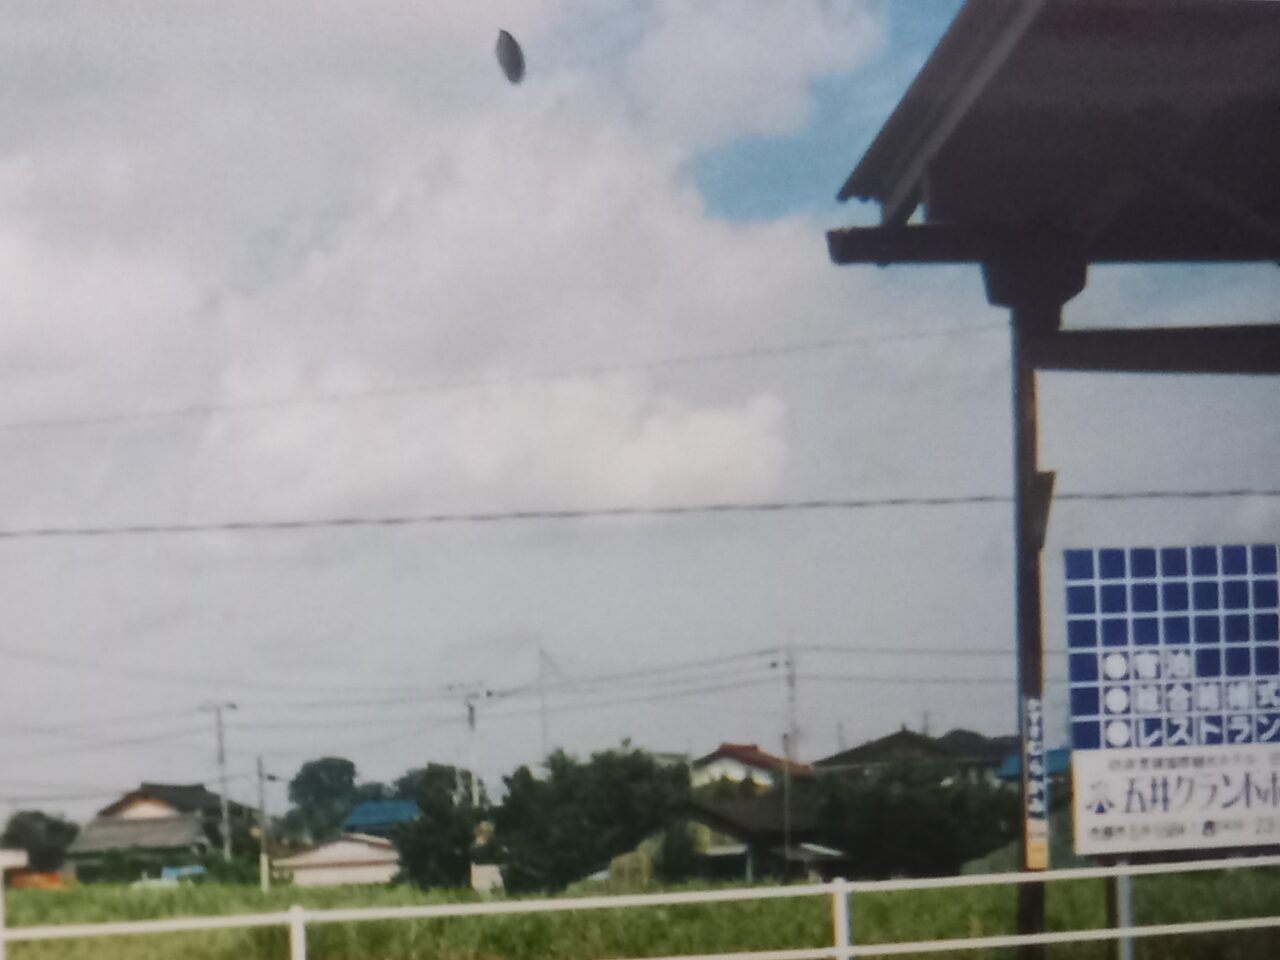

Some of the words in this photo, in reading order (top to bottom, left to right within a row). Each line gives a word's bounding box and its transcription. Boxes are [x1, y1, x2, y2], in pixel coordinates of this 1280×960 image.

[1138, 715, 1279, 747] レストラン
